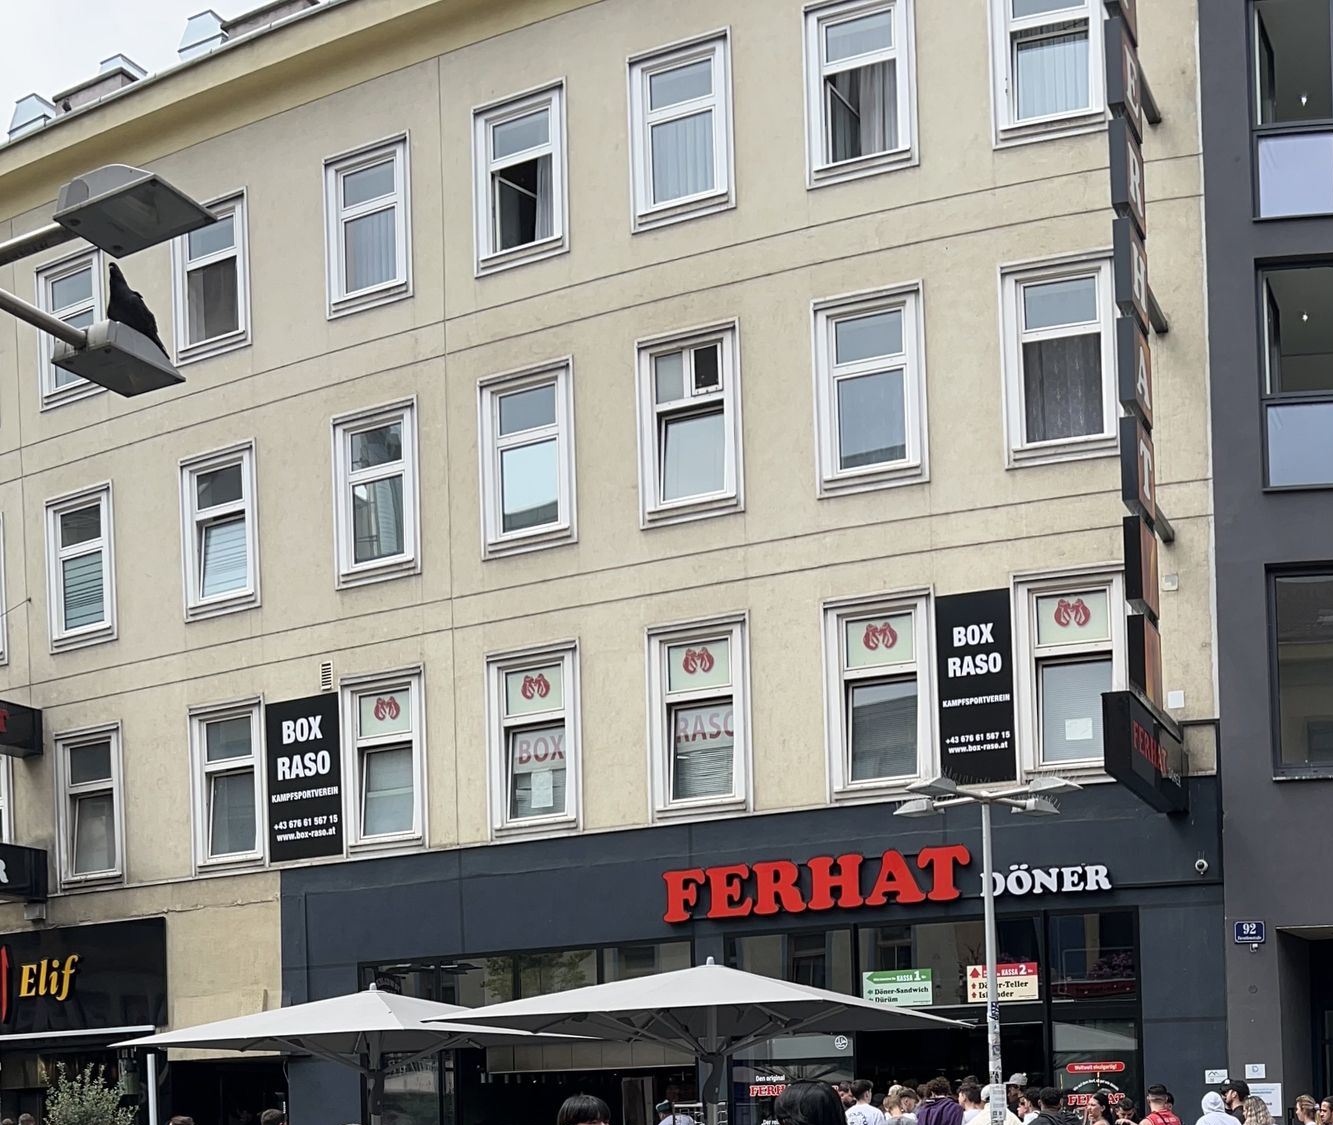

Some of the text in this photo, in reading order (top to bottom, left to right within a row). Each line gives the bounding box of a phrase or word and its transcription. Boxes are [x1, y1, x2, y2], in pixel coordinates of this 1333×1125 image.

[952, 623, 995, 647] BOX
[947, 652, 1002, 678] RASO
[942, 693, 1010, 708] KAMPFSPORTVEREIN
[282, 715, 323, 745] BOX
[945, 736, 960, 744] +43
[960, 734, 974, 743] 676
[975, 733, 984, 741] 61
[1001, 730, 1010, 739] 15
[518, 734, 564, 764] BOX
[948, 741, 1008, 754] www.box-raso.at
[1132, 719, 1169, 778] FERHAT
[277, 750, 331, 781] RASO
[271, 786, 339, 803] KAMPFSPORTVEREIN
[274, 814, 338, 831] +43 676 61 567 15
[276, 826, 336, 842] www.box-raso.at
[662, 844, 1112, 925] FERHAT DÖNER
[1243, 923, 1256, 934] 92
[18, 953, 79, 1001] Elif
[896, 974, 913, 982] KASSA
[914, 970, 921, 981] 1
[1001, 968, 1018, 976] KASSA
[1019, 964, 1027, 975] 2
[875, 987, 929, 995] Döner-Sandwich
[978, 980, 1029, 990] Dör-Teller
[1068, 1093, 1126, 1105] FEAT
